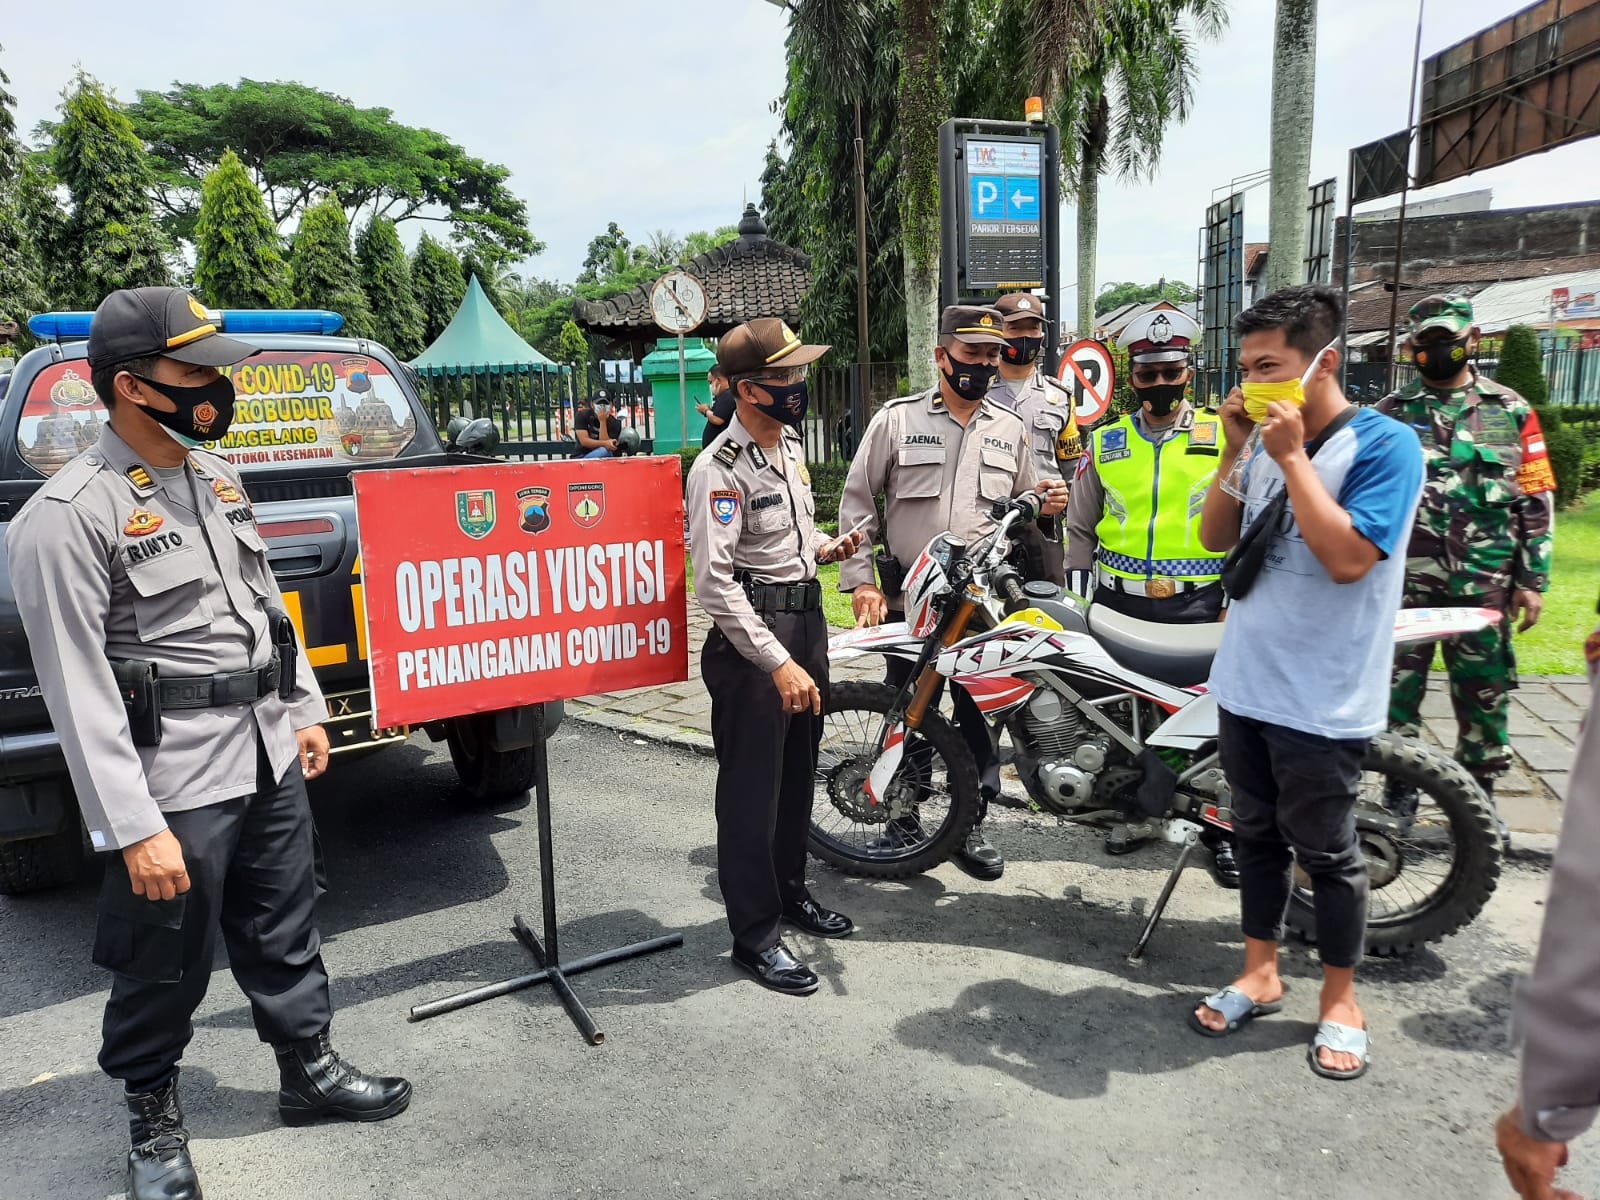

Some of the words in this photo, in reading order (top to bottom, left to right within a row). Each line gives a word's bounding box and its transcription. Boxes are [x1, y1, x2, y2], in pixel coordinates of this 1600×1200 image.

[977, 181, 998, 214] P
[971, 223, 1000, 234] PARKIR
[1001, 223, 1039, 234] TERSEDIA
[241, 361, 336, 394] COVID-19
[232, 396, 335, 424] ROBUDUR
[192, 423, 210, 434] TNI
[221, 426, 318, 449] MAGELANG
[904, 435, 943, 445] ZAENAL
[227, 450, 271, 465] OTOKOL
[273, 447, 334, 461] KESEHATAN
[984, 437, 1013, 451] POLRI
[126, 531, 183, 562] RINTO
[395, 550, 541, 634] OPERASI
[545, 539, 666, 614] YUSTISI
[397, 630, 562, 691] PENANGANAN
[566, 617, 671, 667] COVID-19
